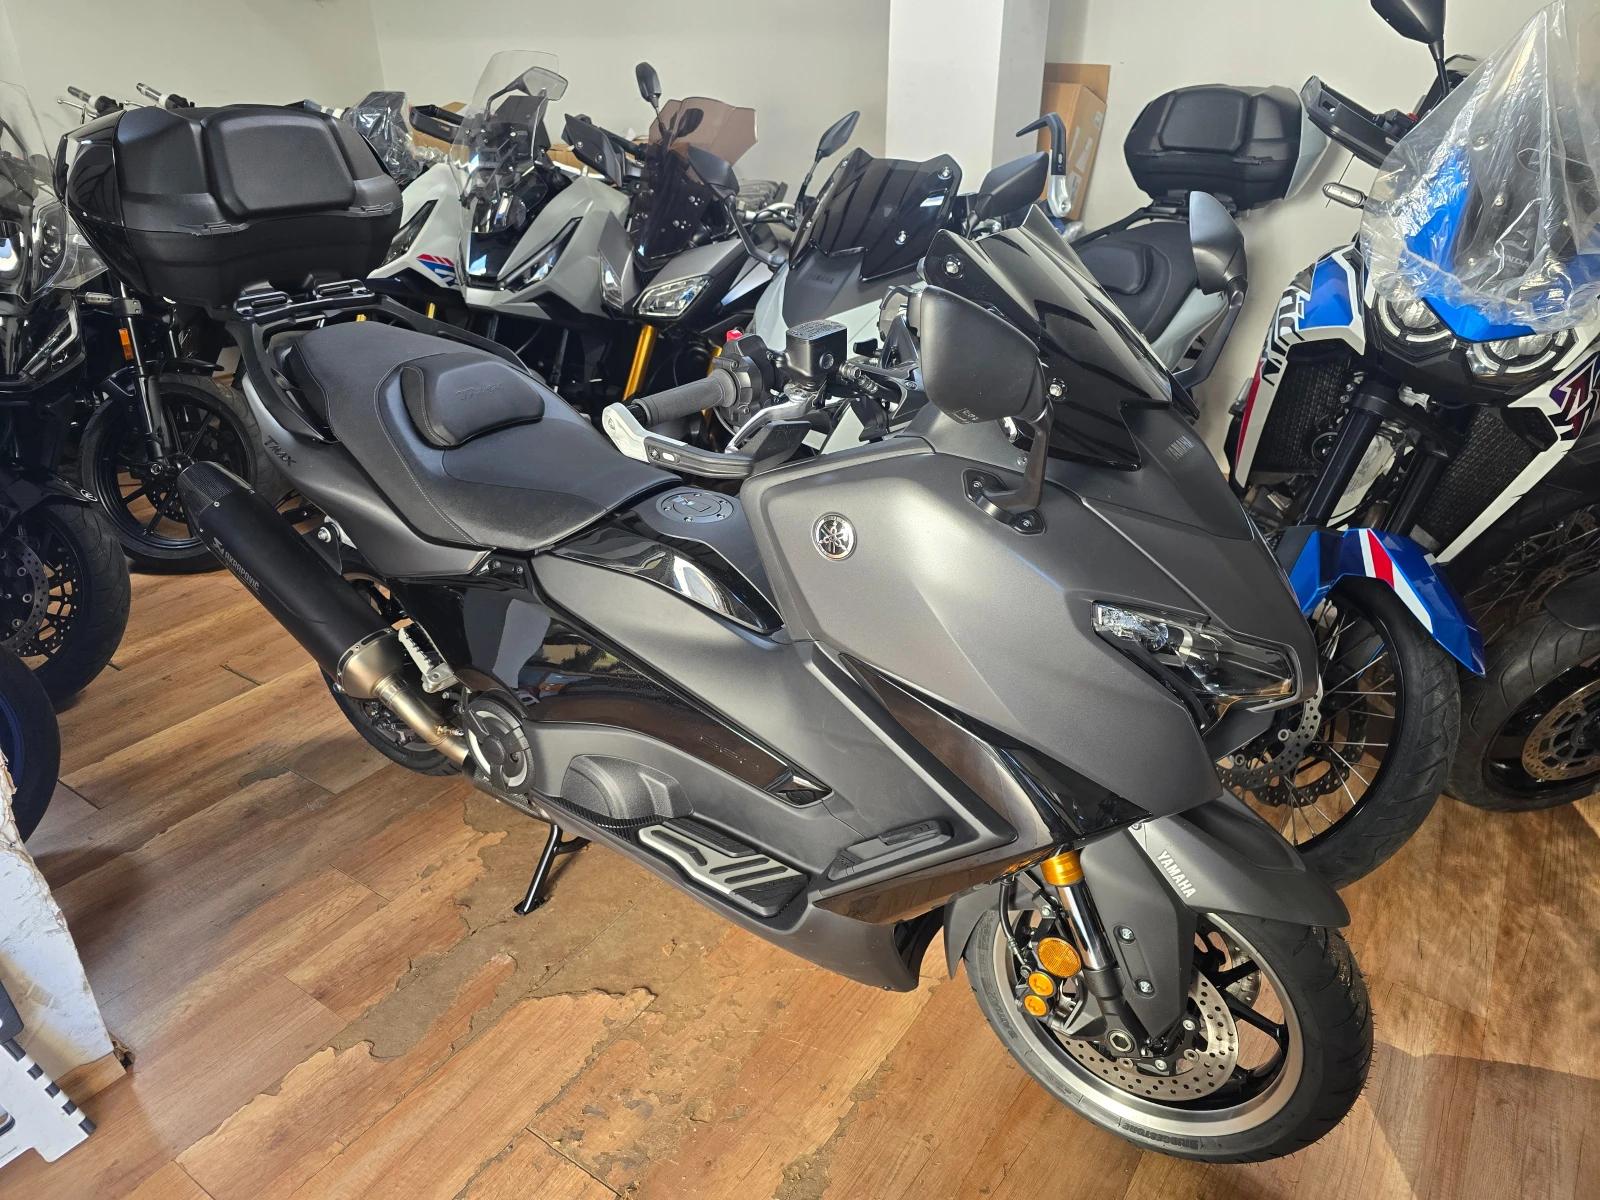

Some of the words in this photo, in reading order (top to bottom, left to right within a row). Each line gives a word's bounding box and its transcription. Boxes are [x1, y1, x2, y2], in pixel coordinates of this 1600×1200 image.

[1486, 249, 1531, 267] HNDA
[264, 434, 297, 467] TMAX
[1157, 849, 1197, 899] YAMAHA
[1121, 1121, 1200, 1150] BRIDGESTONE
